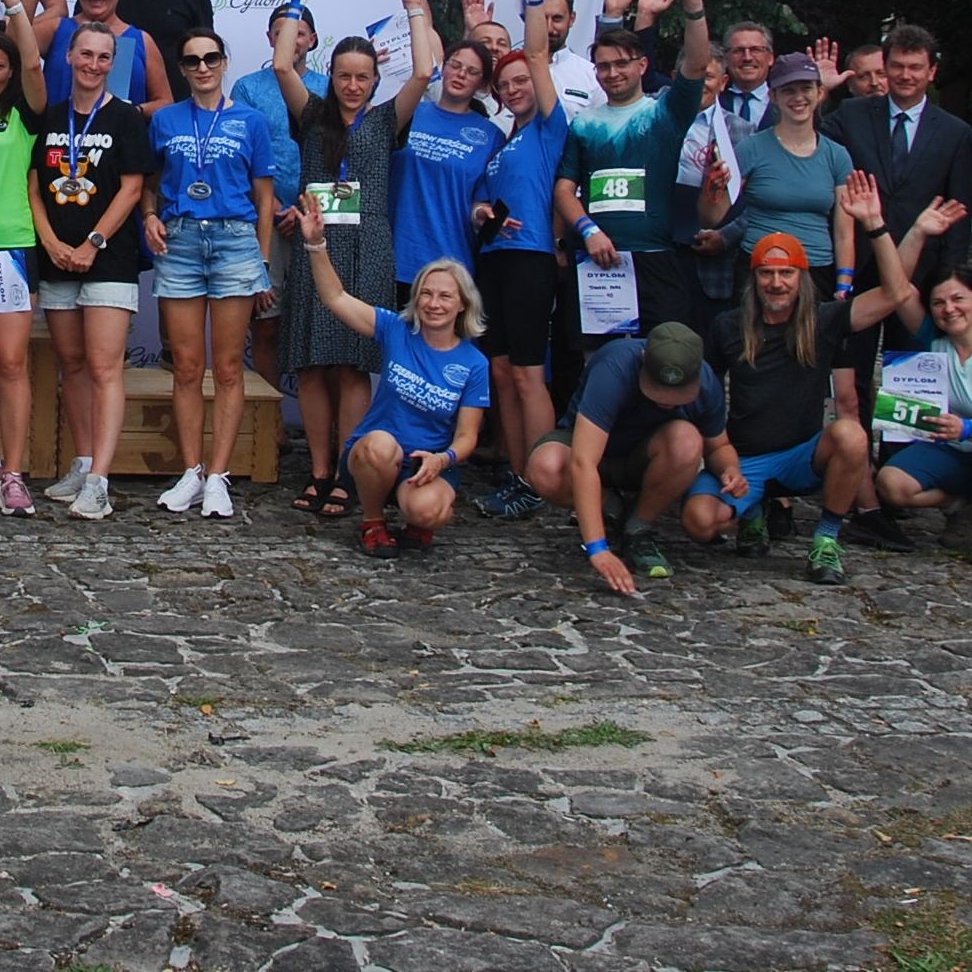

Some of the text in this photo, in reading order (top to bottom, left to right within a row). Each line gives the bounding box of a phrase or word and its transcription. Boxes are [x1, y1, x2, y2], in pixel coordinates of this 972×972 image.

[602, 178, 629, 198] 48
[893, 376, 937, 384] DYPLOM
[892, 400, 920, 425] 51
